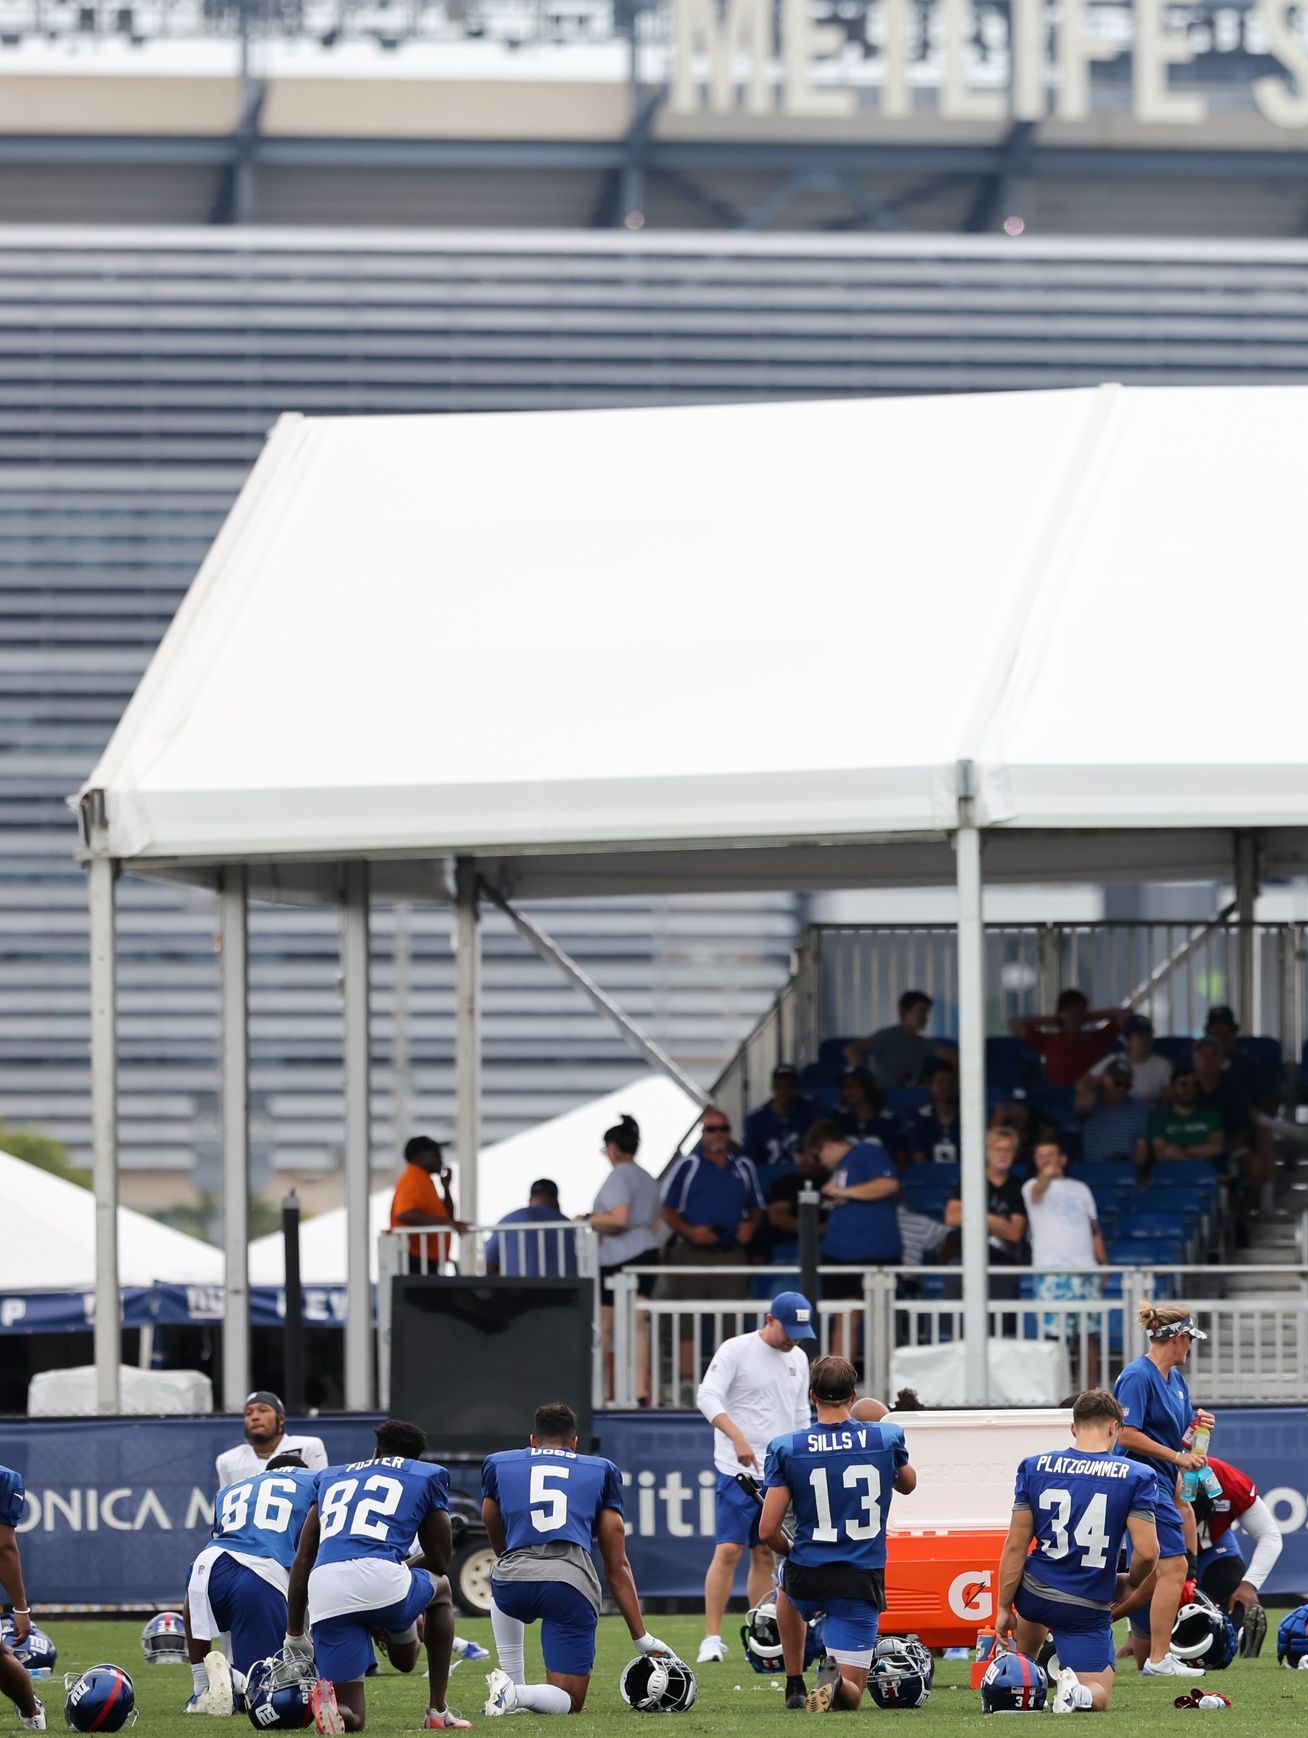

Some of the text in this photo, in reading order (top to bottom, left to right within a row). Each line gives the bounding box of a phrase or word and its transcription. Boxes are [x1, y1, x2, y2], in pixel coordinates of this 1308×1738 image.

[808, 1430, 867, 1452] SILLS V
[1036, 1456, 1130, 1479] PLATZGUMMER
[220, 1477, 298, 1534] 86
[319, 1474, 404, 1545] 82
[530, 1464, 570, 1533] 5
[809, 1465, 882, 1542] 13
[1039, 1488, 1110, 1568] 34
[948, 1570, 994, 1621] G
[1014, 1696, 1034, 1708] 34
